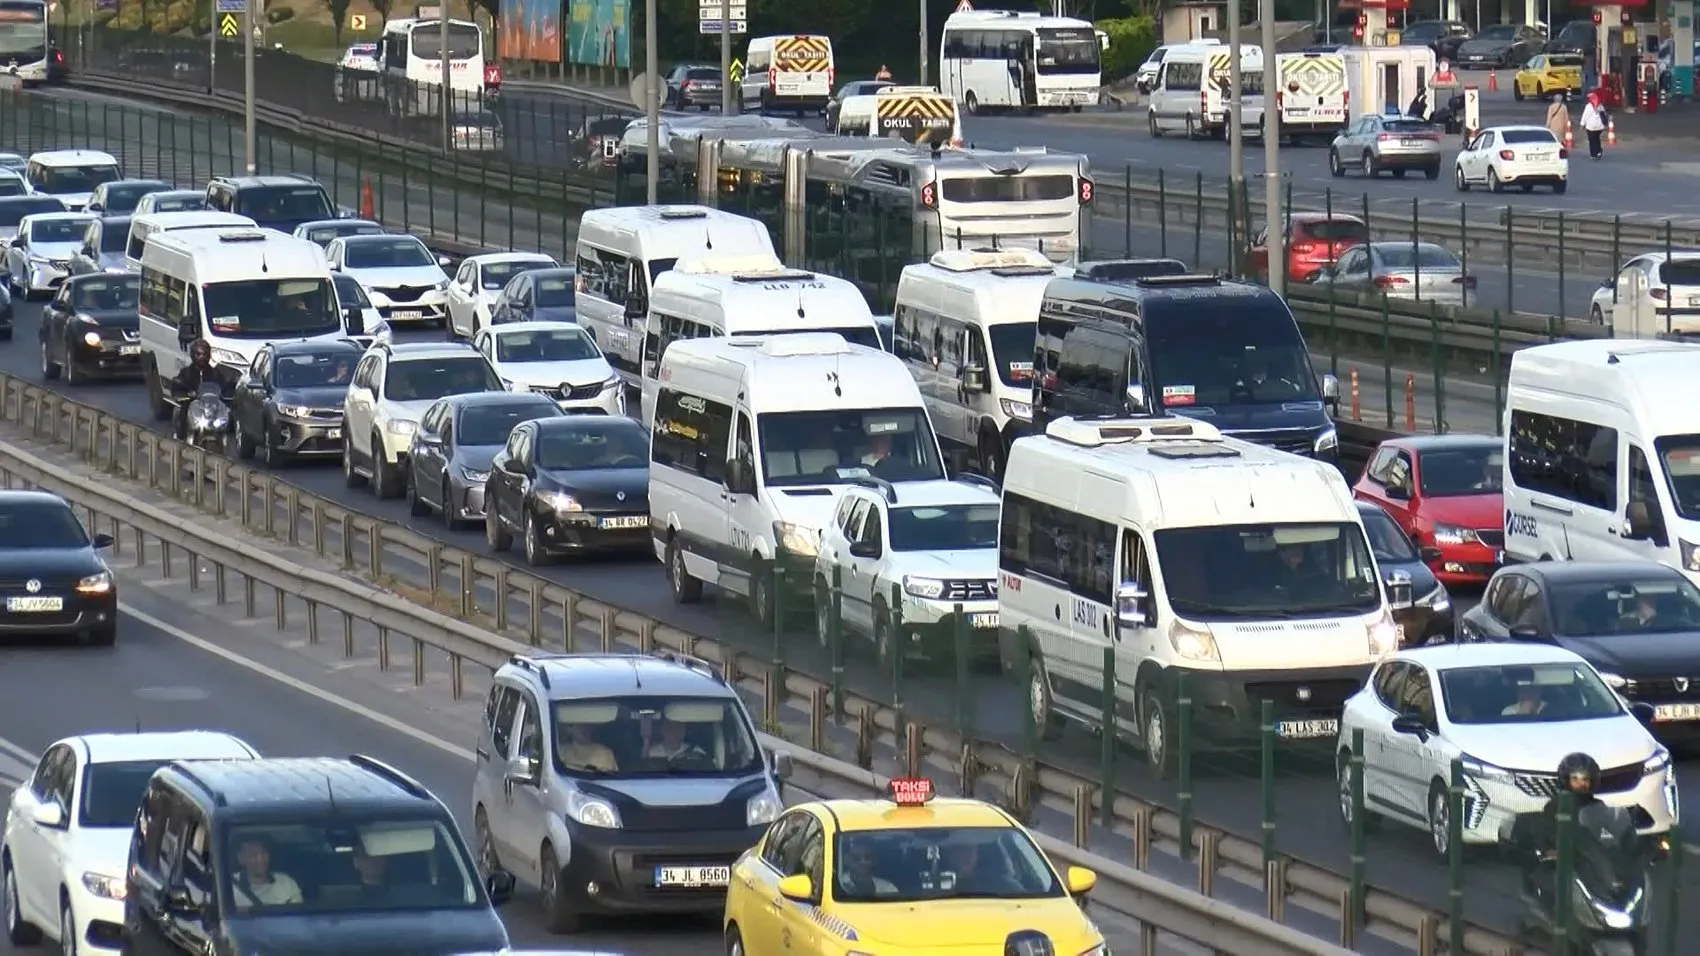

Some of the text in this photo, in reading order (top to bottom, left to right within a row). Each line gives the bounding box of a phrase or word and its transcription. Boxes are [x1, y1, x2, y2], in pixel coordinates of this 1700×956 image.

[883, 118, 912, 128] OKUL
[662, 869, 676, 882] 34
[682, 868, 694, 882] JL
